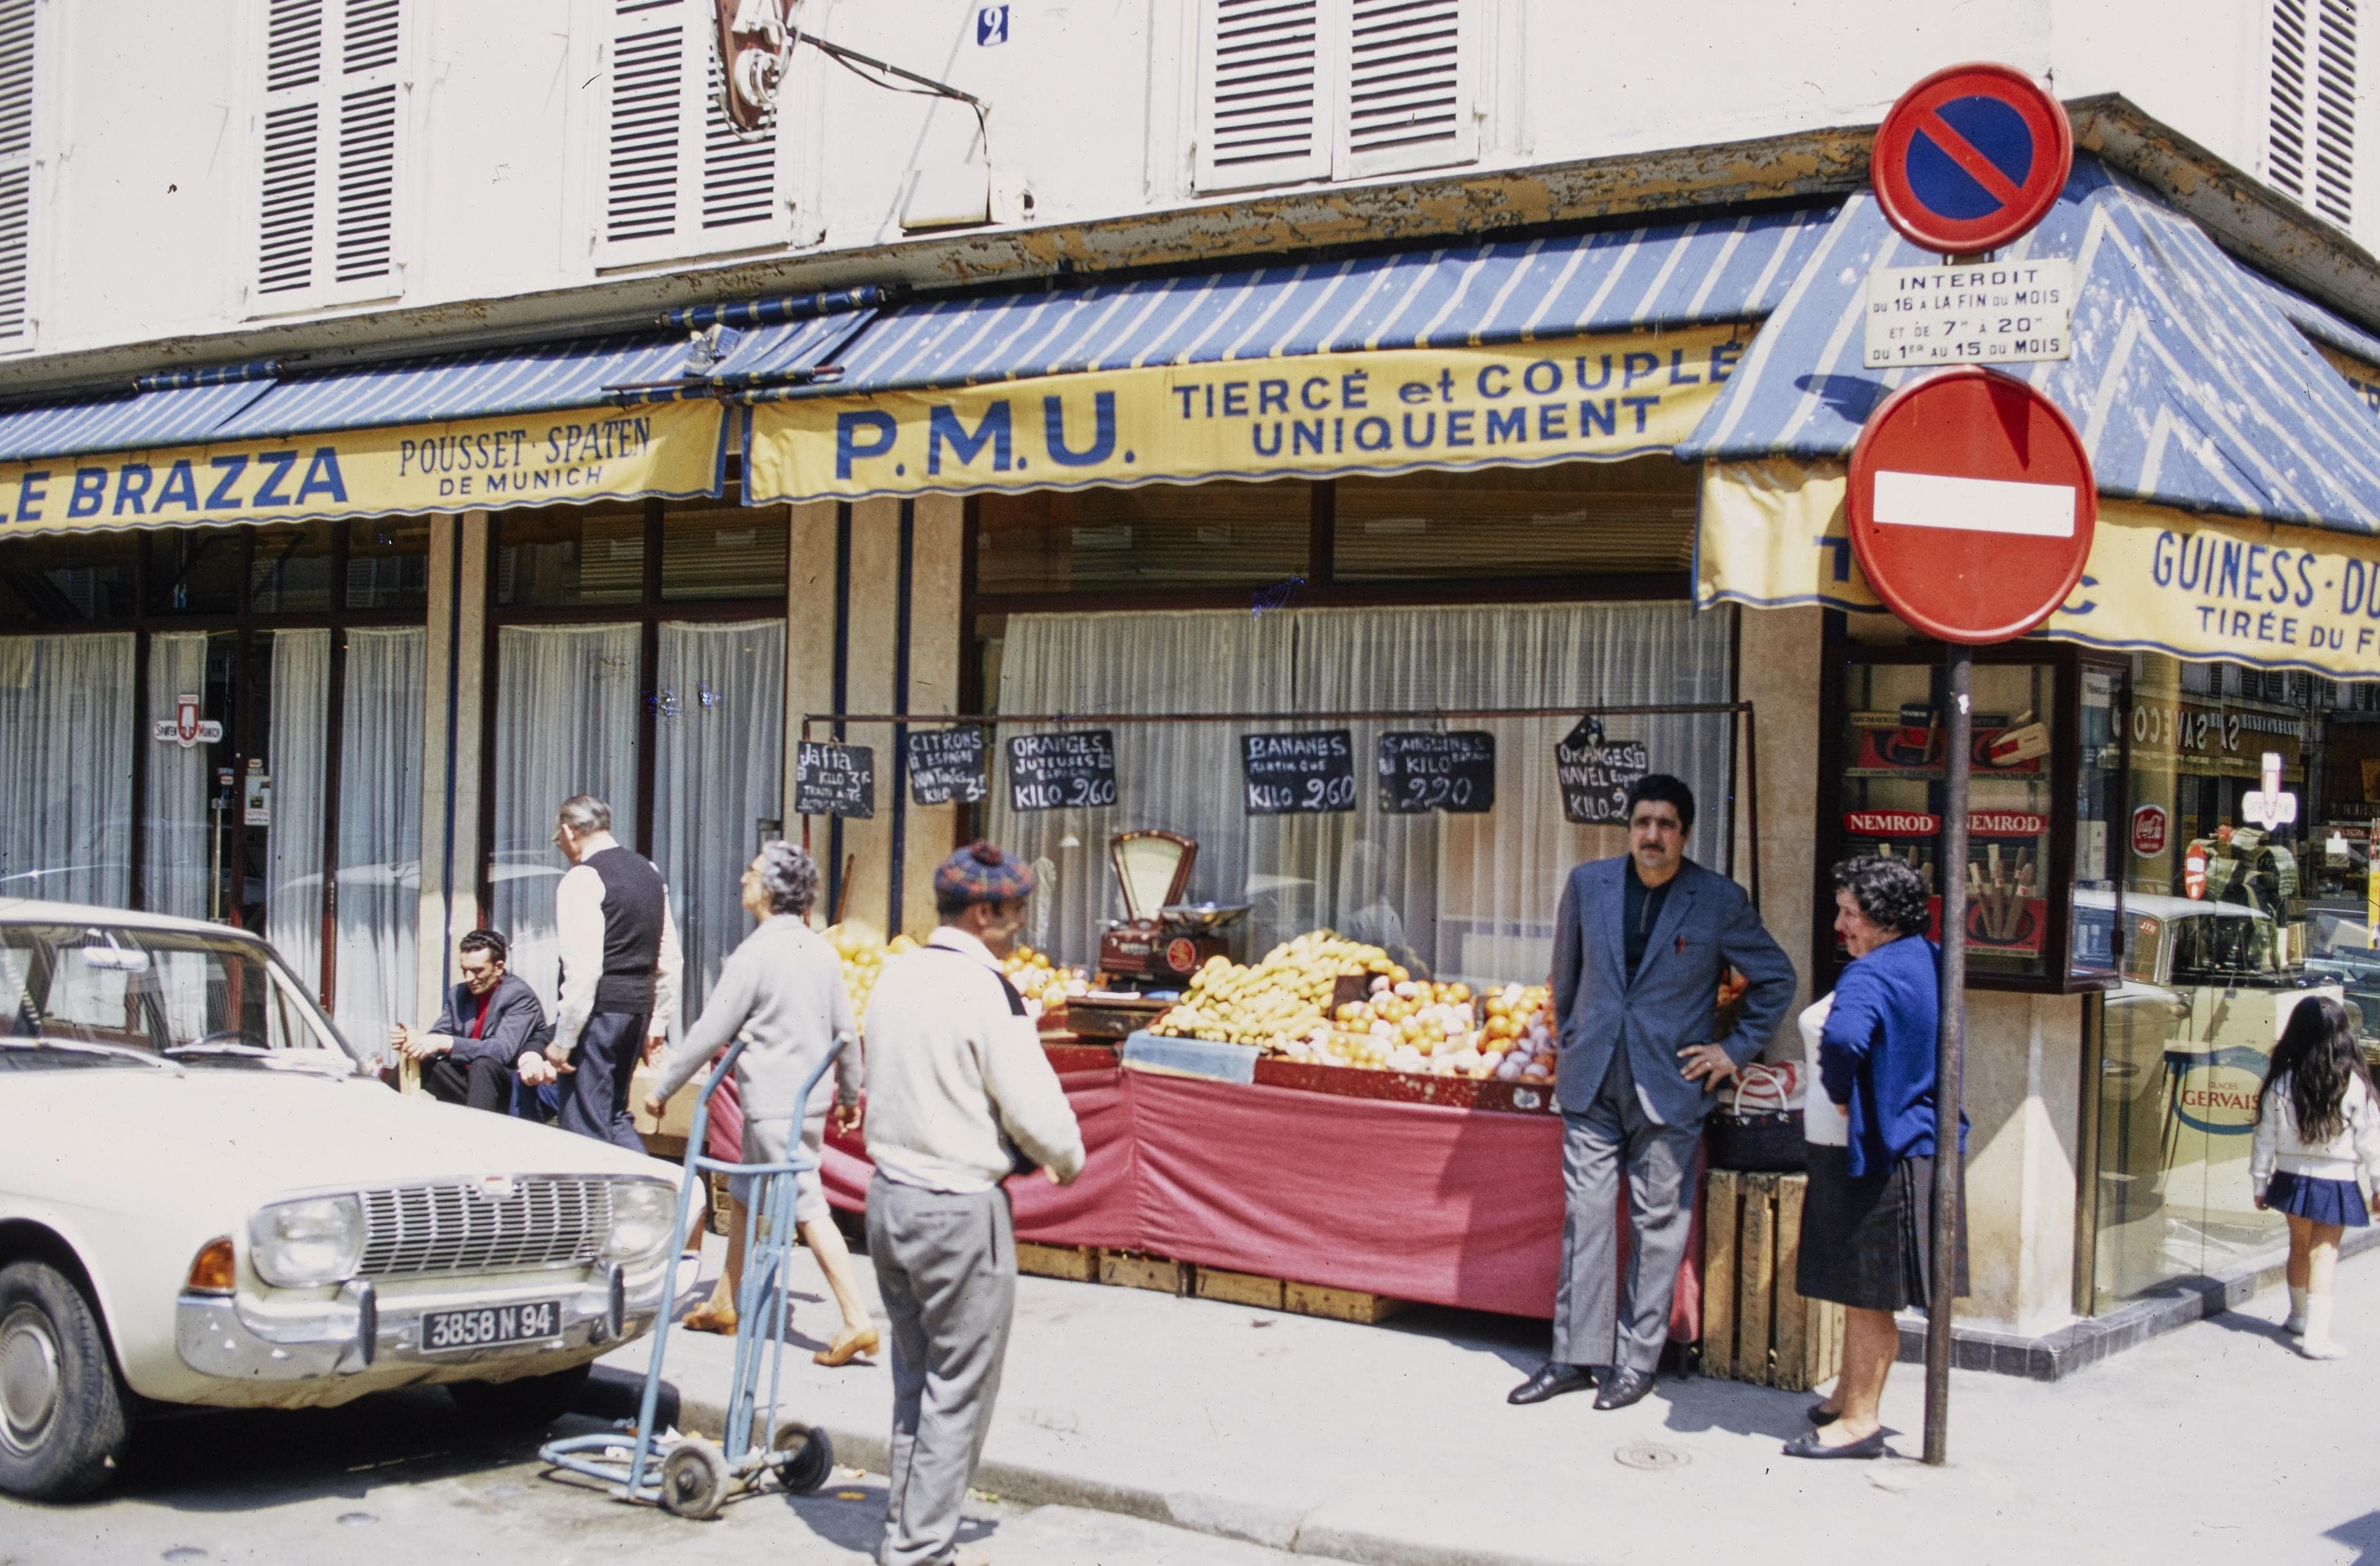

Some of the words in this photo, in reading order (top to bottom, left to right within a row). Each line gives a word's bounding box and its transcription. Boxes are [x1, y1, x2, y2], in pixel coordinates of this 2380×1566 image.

[984, 6, 1002, 46] 2
[1899, 269, 2038, 291] INTERDIT
[1873, 303, 1887, 313] DU
[1894, 295, 1913, 311] 16
[1934, 295, 1950, 309] LA
[1958, 294, 1986, 308] FIN
[1993, 296, 2008, 307] DU
[2015, 289, 2059, 305] MOIS
[1889, 327, 1904, 339] ET
[1914, 326, 1930, 338] DE
[1873, 349, 1890, 360] DU
[1930, 346, 1948, 358] AU
[1955, 341, 1981, 356] 15
[1990, 344, 2006, 355] DU
[2014, 338, 2059, 354] MOIS
[1173, 368, 1369, 420] TIERCÉ
[1398, 369, 1454, 405] et
[836, 390, 1136, 480] P.M.U.
[1252, 395, 1661, 457] UNIQUEMENT
[399, 430, 527, 477] POUSSET
[545, 416, 652, 463] SPATEN
[0, 470, 51, 524] E
[66, 446, 349, 518] BRAZZA
[439, 477, 473, 496] DE
[486, 466, 603, 493] MUNICH
[2154, 530, 2317, 608] GUINESS
[2196, 605, 2298, 645] TIRÉE
[2309, 625, 2343, 650] DU
[909, 730, 983, 751] CITRONS
[1012, 735, 1104, 758] ORANGES
[1247, 736, 1348, 761] BANANES
[1405, 755, 1452, 774] KILO
[1560, 743, 1634, 769] ORANGES
[1559, 765, 1609, 787] NAVEL
[1014, 783, 1062, 809] KILO
[1249, 782, 1294, 808] KILO
[1570, 793, 1609, 820] KILO
[1850, 814, 1934, 832] NEMROD
[2182, 1089, 2262, 1111] GERVAIS
[432, 1309, 495, 1347] 3858
[499, 1307, 517, 1340] N
[520, 1303, 554, 1337] 94
